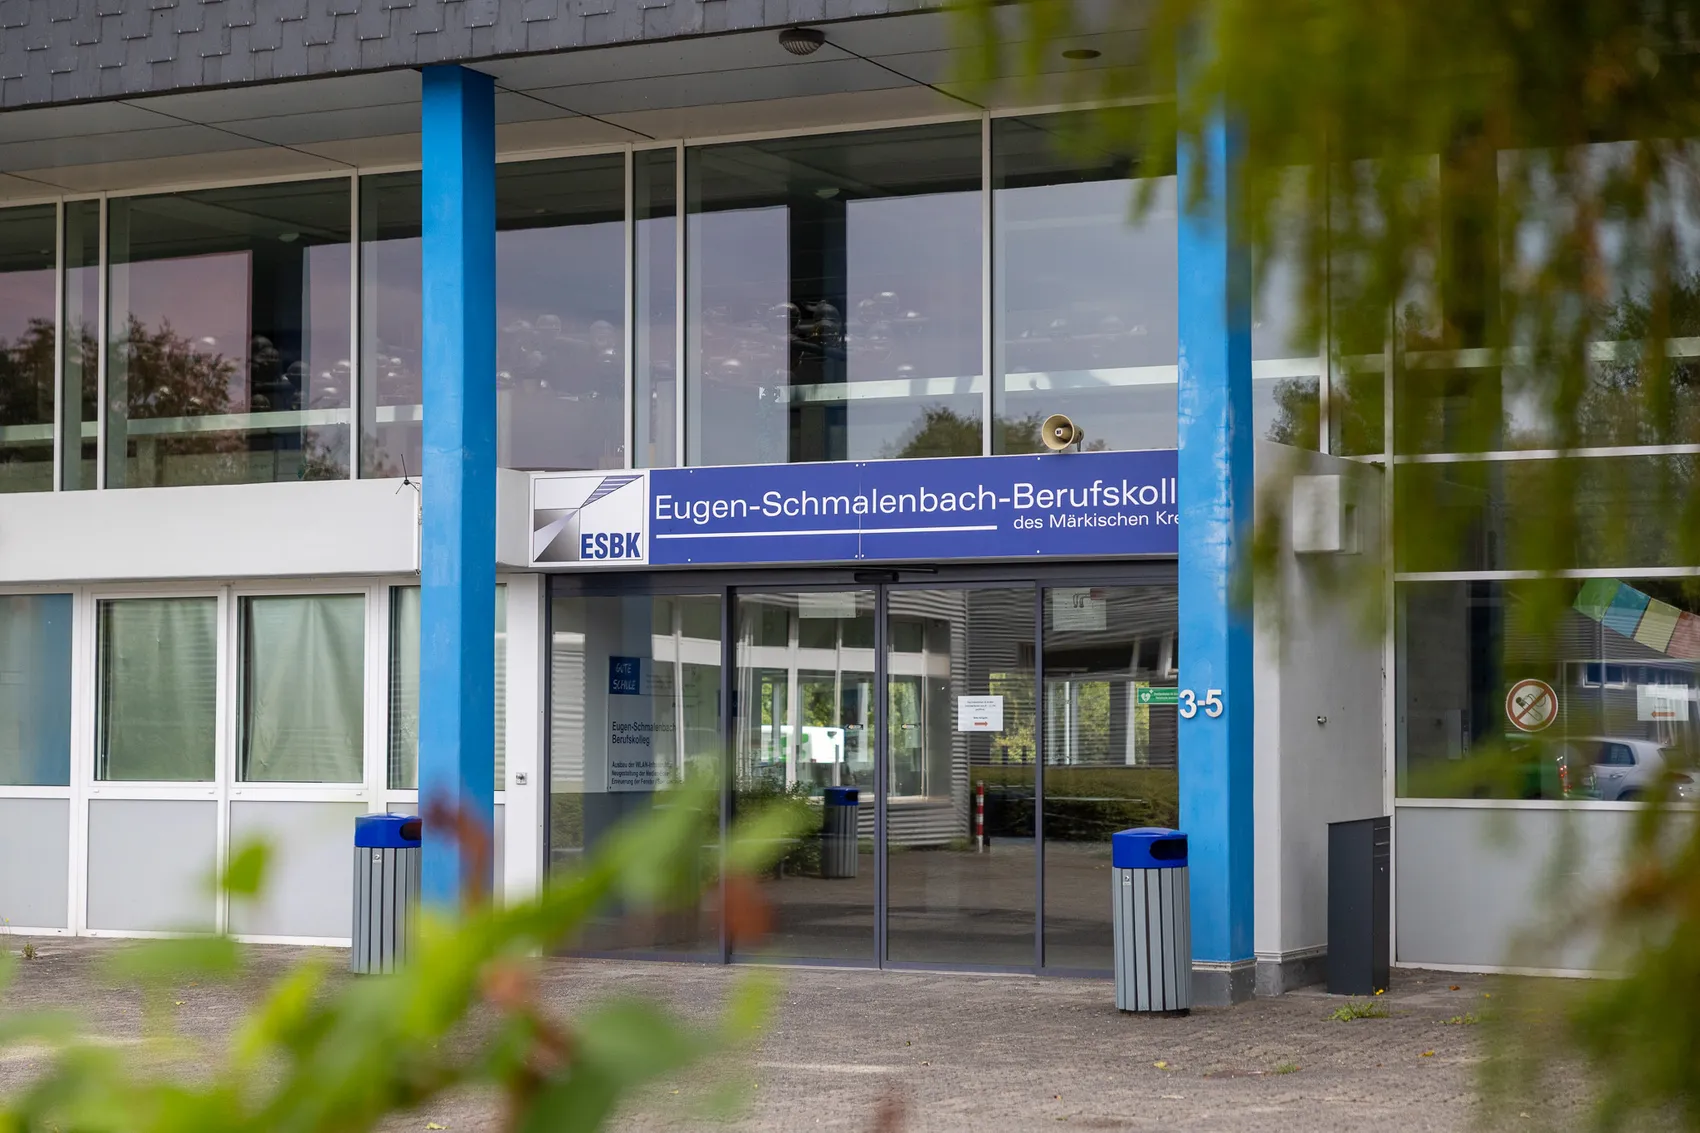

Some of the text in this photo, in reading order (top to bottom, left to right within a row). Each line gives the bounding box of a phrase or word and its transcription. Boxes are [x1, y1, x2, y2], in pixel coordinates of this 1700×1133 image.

[655, 477, 1177, 526] Eugen-Schmalenbach-Berufskoll
[1013, 510, 1179, 530] des Märkischen Kre
[581, 532, 641, 559] ESBK
[1179, 689, 1223, 719] 3-5
[612, 734, 650, 747] Berufskolleg
